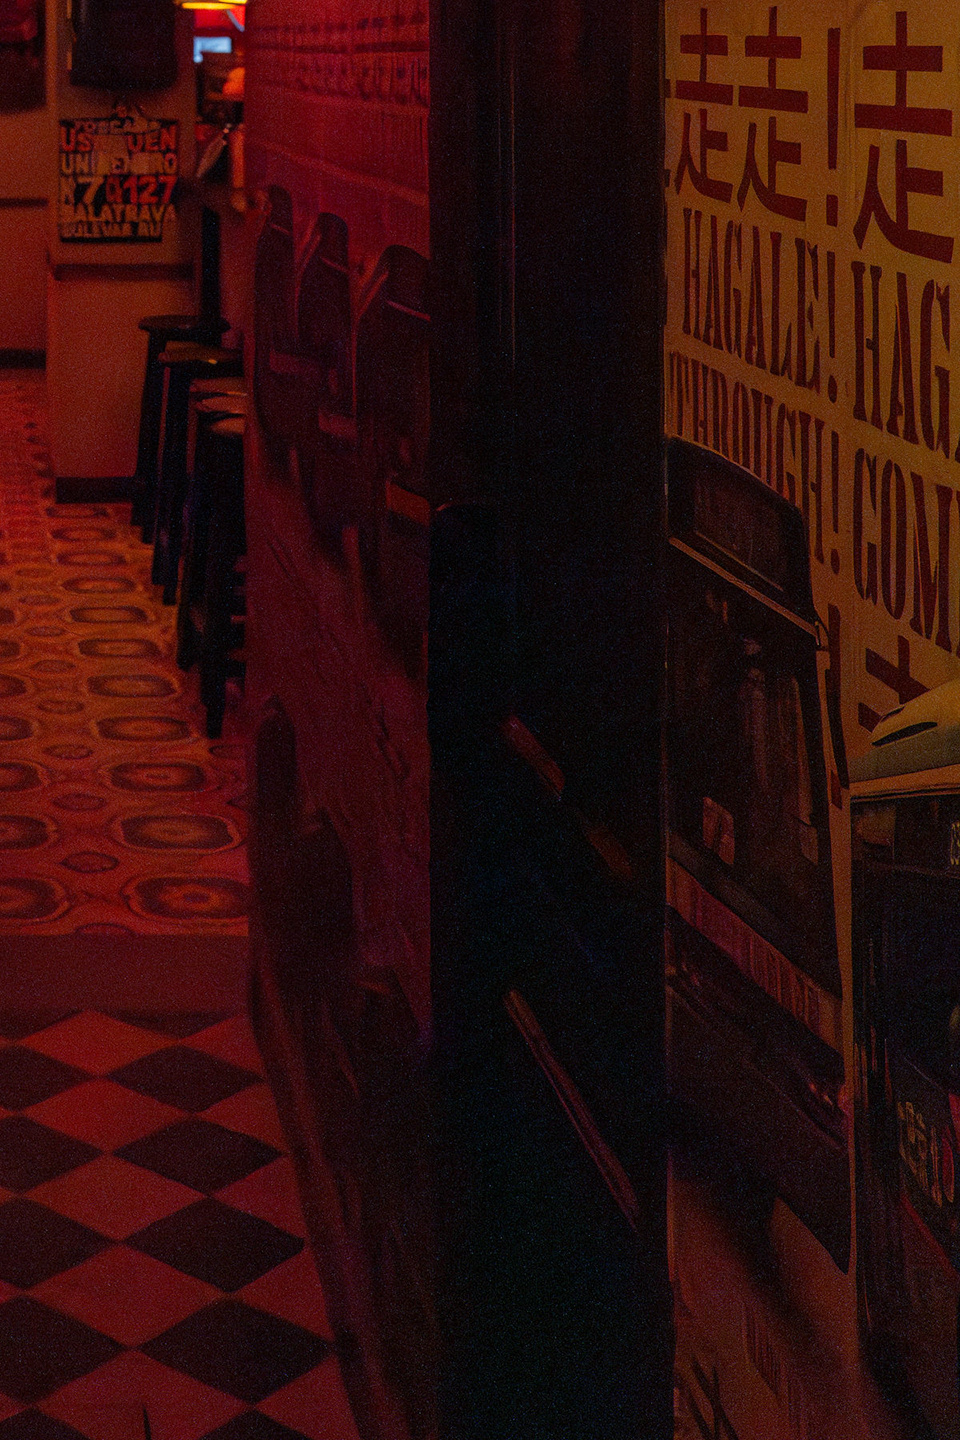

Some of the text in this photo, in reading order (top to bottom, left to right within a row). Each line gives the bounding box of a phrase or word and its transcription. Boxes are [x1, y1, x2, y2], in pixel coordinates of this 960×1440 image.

[680, 207, 960, 459] HAGALE! HAG
[852, 447, 960, 655] COM
